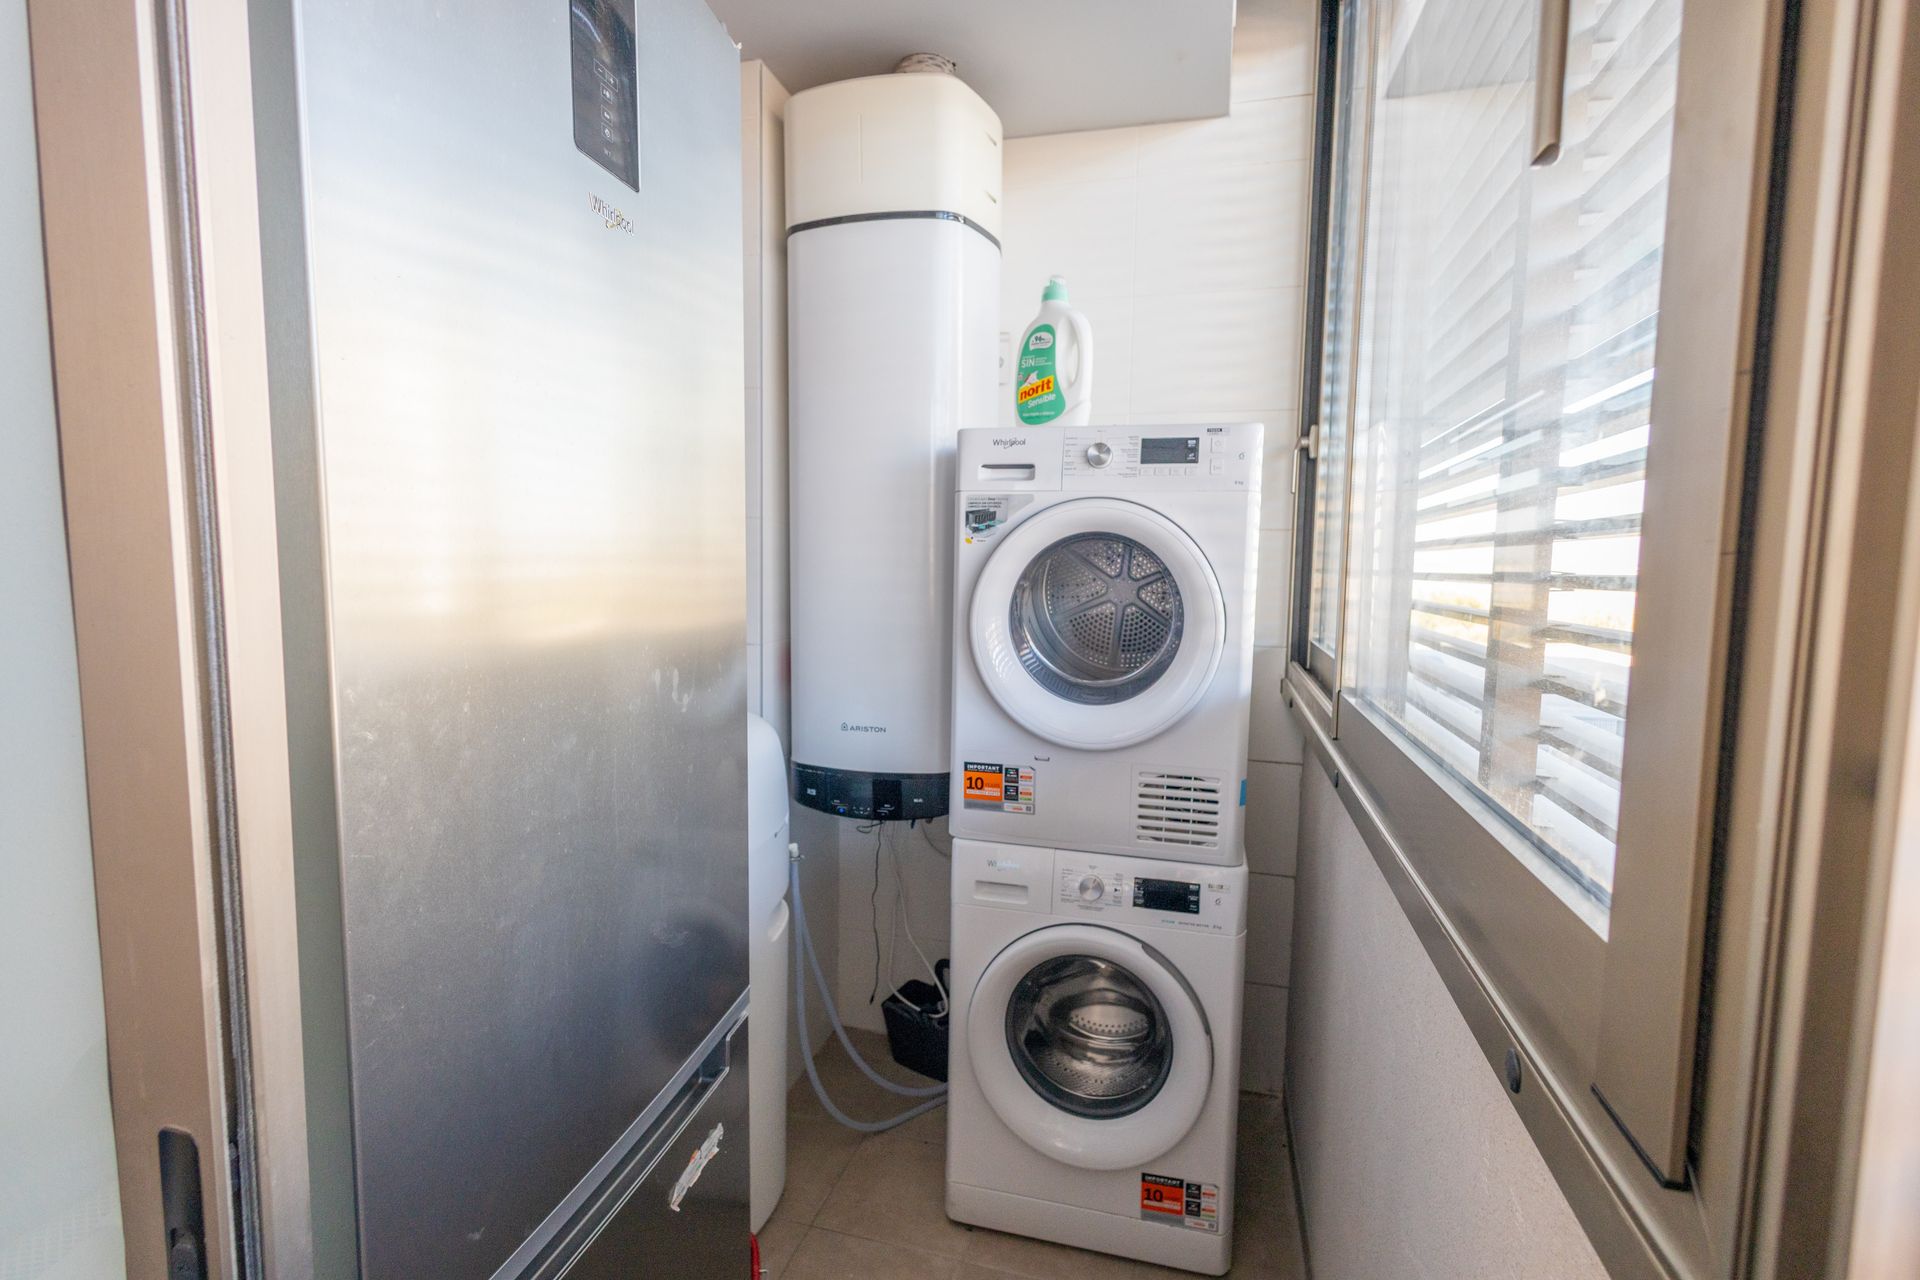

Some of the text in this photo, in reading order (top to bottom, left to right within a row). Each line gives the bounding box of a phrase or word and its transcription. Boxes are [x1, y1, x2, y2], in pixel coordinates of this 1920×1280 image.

[588, 191, 634, 235] Whirlpool
[1019, 378, 1052, 401] norit
[992, 437, 1026, 449] Whirlpool
[849, 725, 887, 733] ARISTON
[966, 776, 984, 790] 10
[1143, 1188, 1164, 1202] 10
